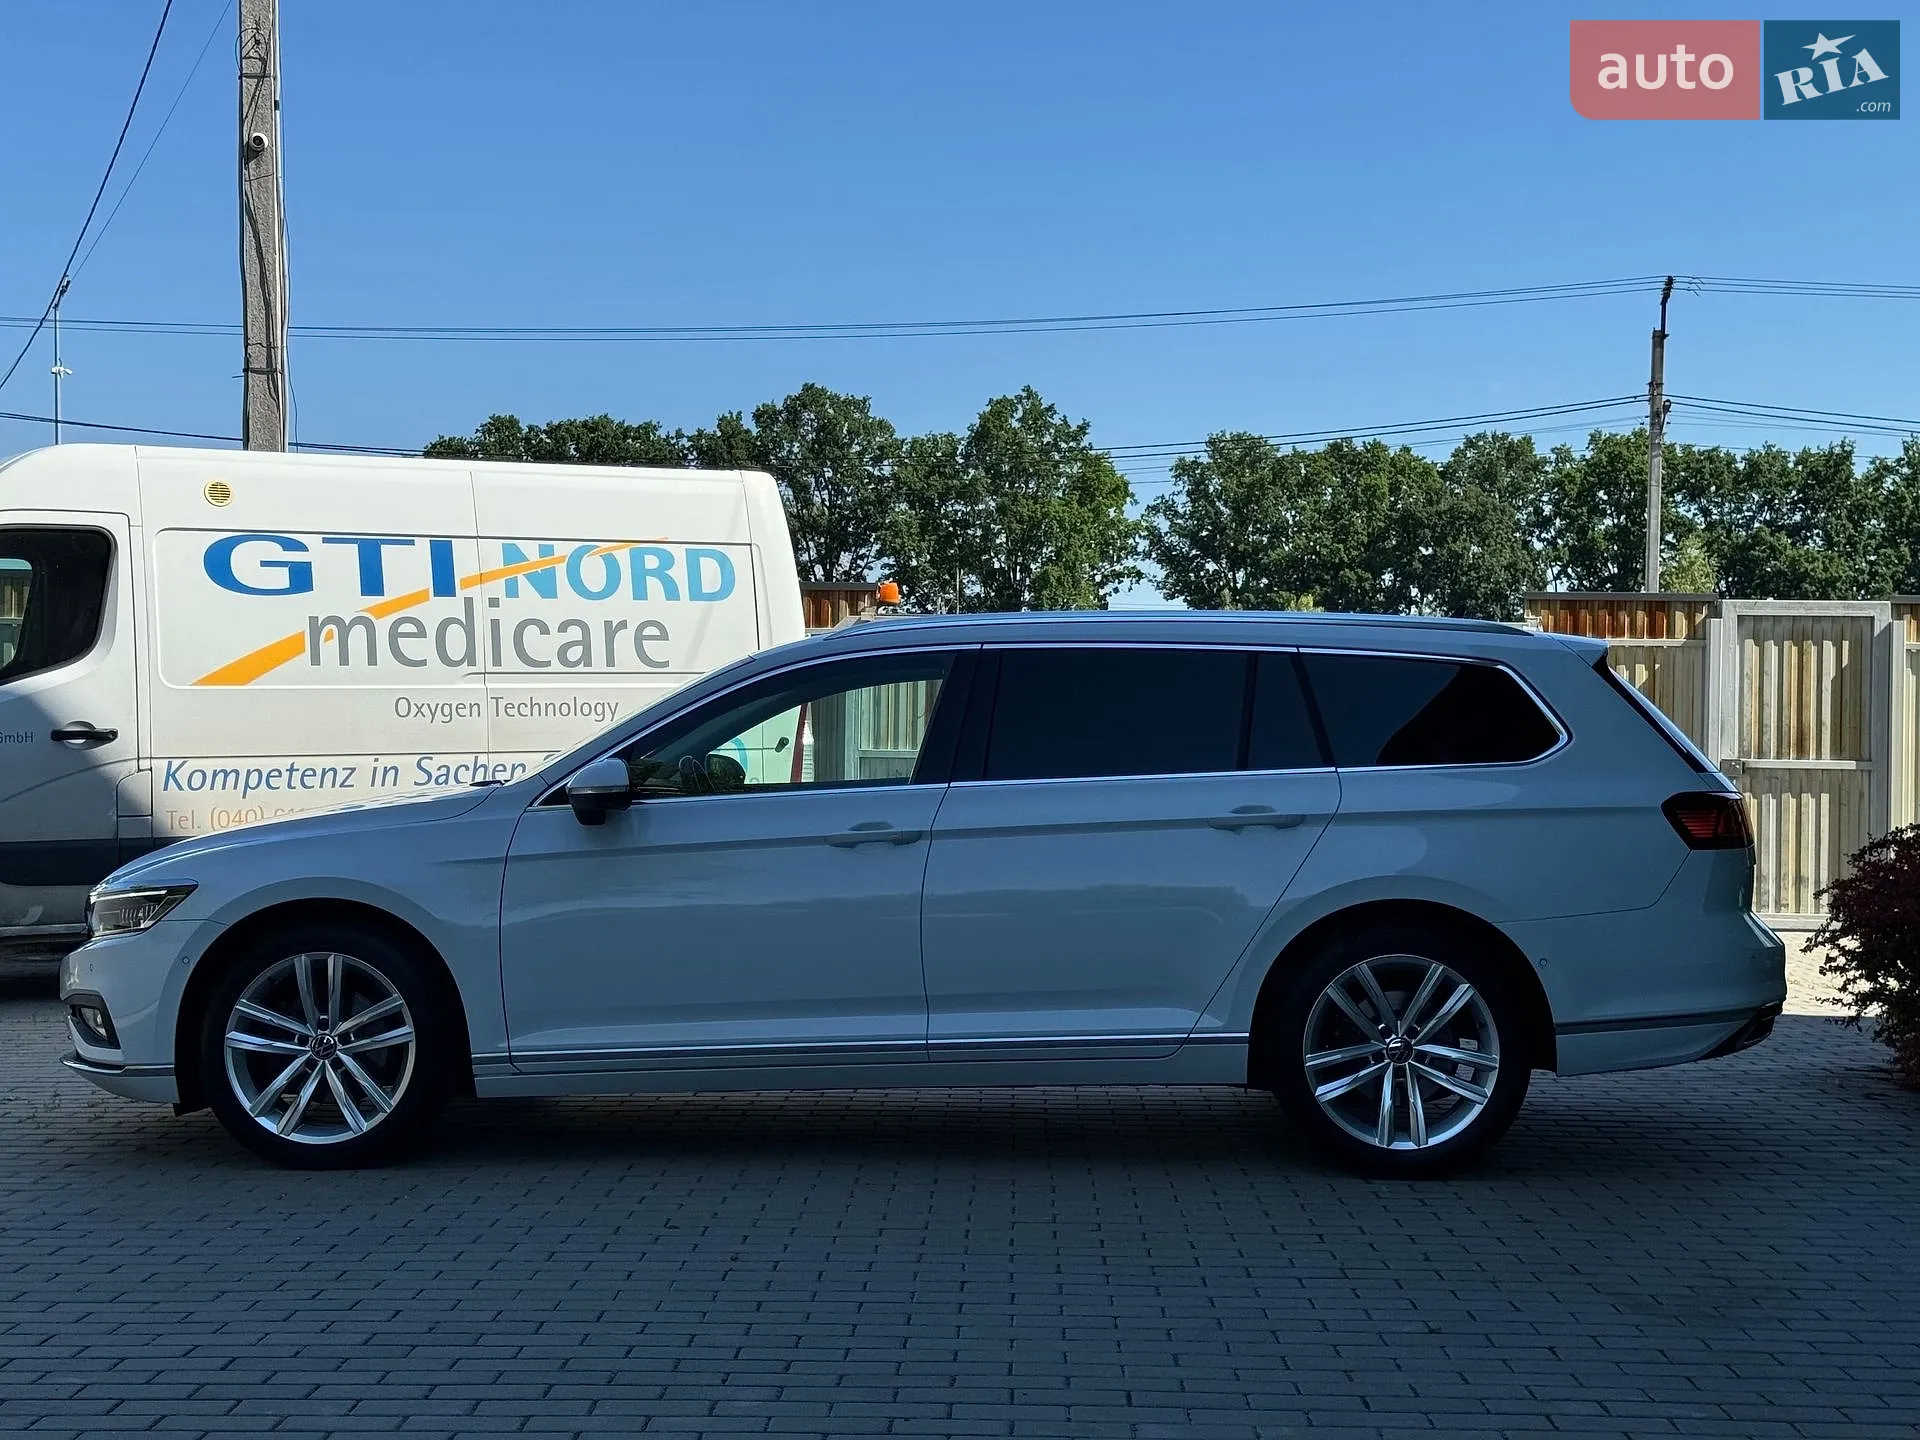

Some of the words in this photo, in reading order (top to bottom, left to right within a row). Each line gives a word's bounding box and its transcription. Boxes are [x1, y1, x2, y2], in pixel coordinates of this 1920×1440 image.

[203, 534, 457, 598] GTI
[501, 542, 737, 603] NORD
[308, 596, 670, 669] medicare
[394, 696, 482, 724] Oxygen
[490, 696, 619, 723] Technology
[162, 759, 358, 800] Kompetenz
[370, 757, 399, 788] in
[413, 755, 527, 788] Sachen
[166, 809, 202, 831] Tel.
